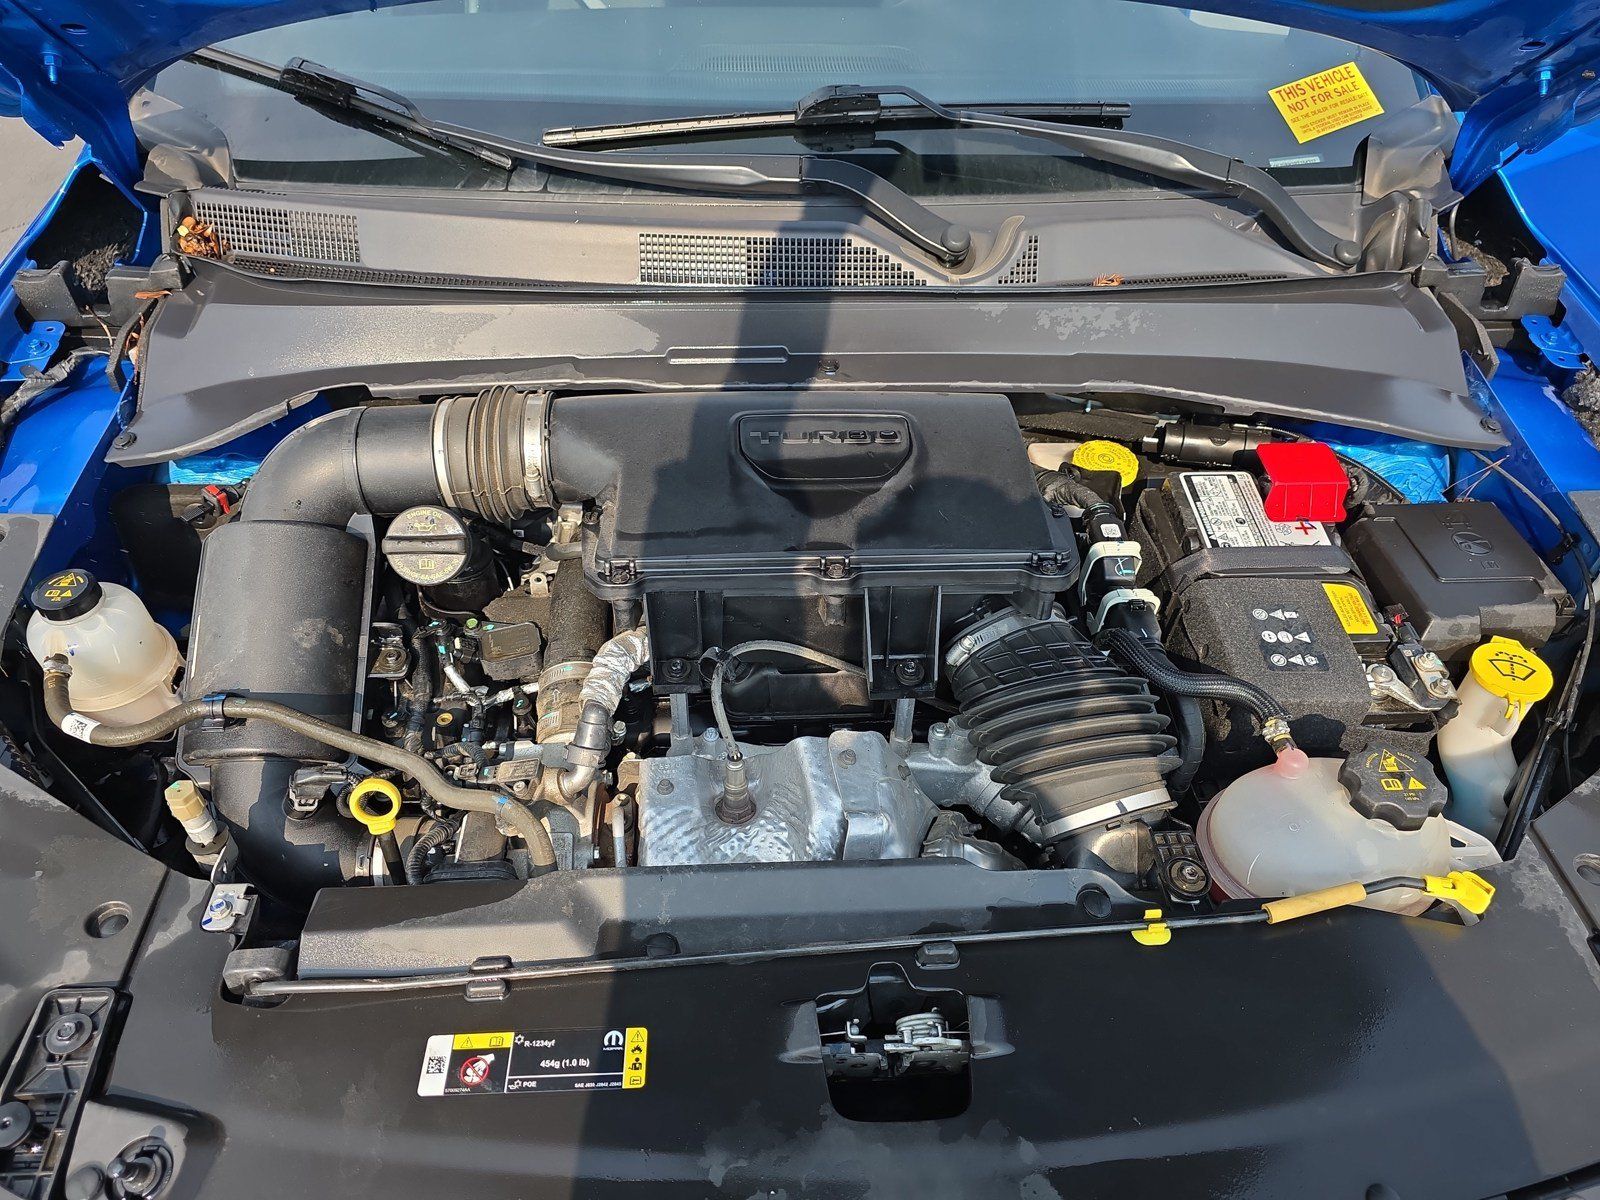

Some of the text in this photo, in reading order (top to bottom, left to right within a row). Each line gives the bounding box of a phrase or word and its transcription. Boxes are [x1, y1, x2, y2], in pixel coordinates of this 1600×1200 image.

[1275, 66, 1355, 102] THIS VEHICLE
[1287, 81, 1360, 113] NOT FOR SALE
[1310, 105, 1329, 115] DEALER
[750, 429, 902, 445] TURBO
[406, 509, 443, 519] ENGINE OIL
[524, 1039, 556, 1048] R-1234yf
[540, 1057, 590, 1069] 454g (1.0 lb)
